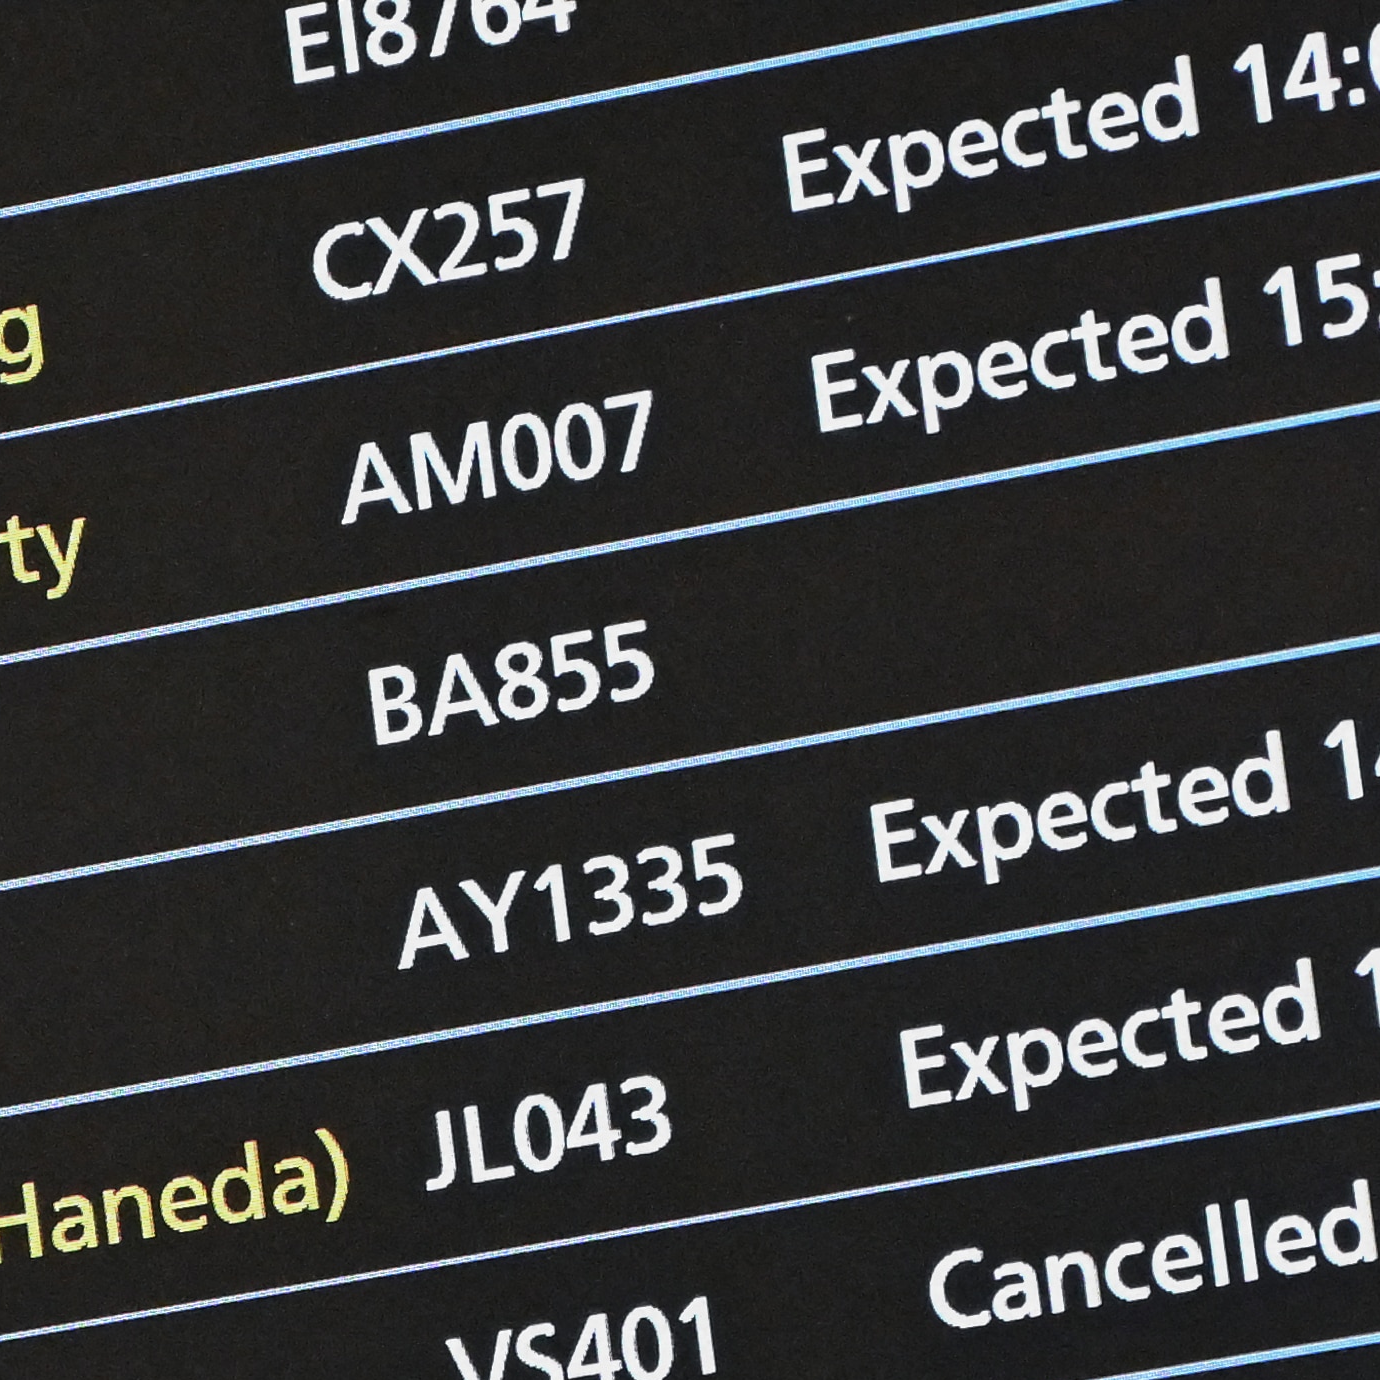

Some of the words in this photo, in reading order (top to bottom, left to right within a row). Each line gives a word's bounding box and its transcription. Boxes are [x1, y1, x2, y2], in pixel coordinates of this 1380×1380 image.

[783, 55, 1199, 212] Expected
[313, 178, 585, 300] CX257
[811, 277, 1229, 434] Expected
[341, 390, 652, 525] AM007
[368, 620, 654, 745] BA855
[870, 730, 1290, 884] Expected
[398, 833, 743, 970] AY1335
[900, 957, 1321, 1111] Expected
[426, 1075, 671, 1191] JL043
[930, 1179, 1378, 1328] Cancelled
